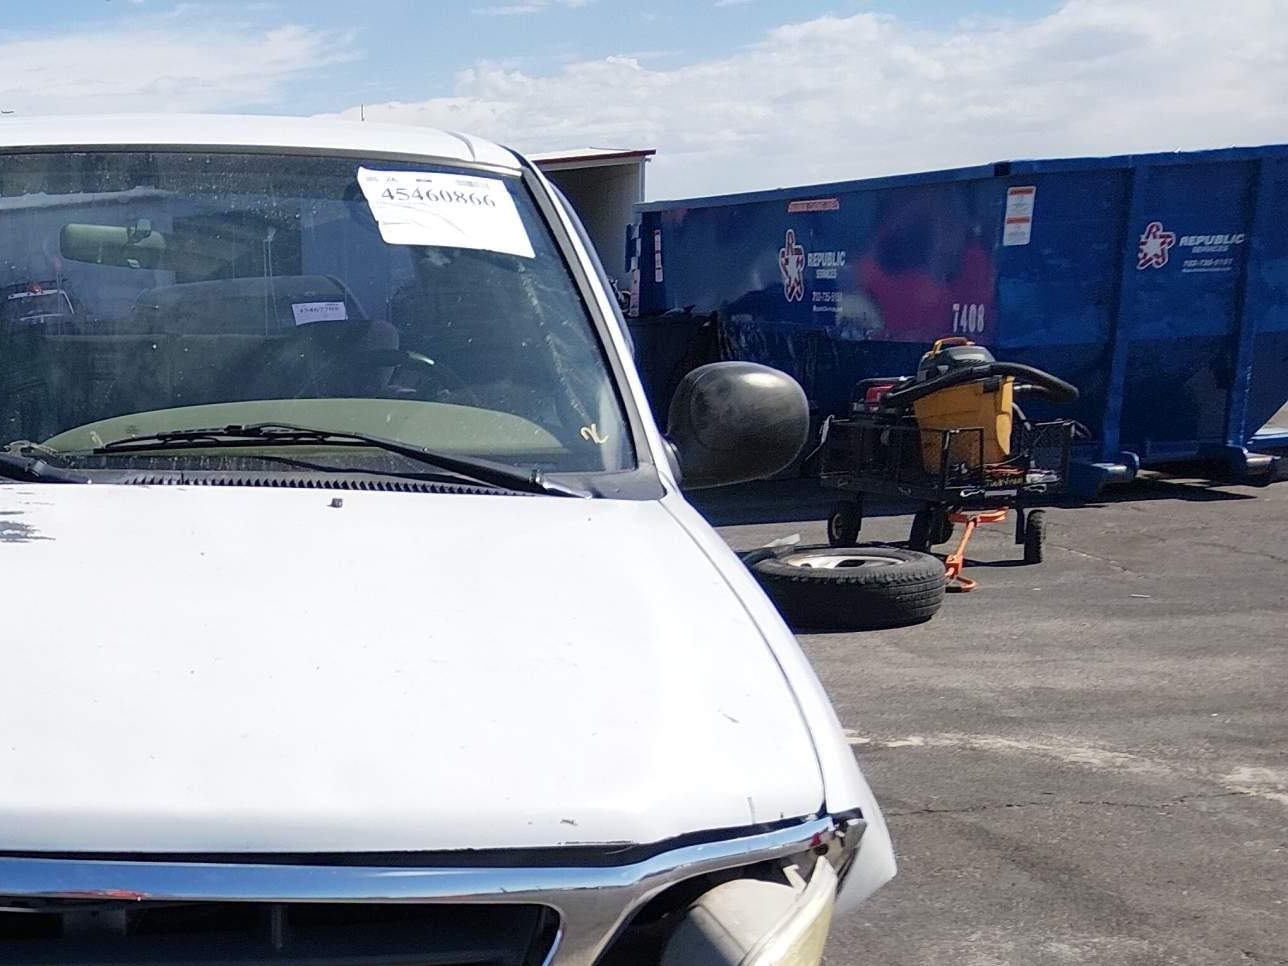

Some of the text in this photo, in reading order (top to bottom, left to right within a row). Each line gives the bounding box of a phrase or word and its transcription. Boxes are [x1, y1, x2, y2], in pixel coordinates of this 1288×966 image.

[380, 187, 497, 208] 45460866
[1179, 233, 1245, 247] REPUBLIC
[807, 251, 846, 266] REPUBLIC
[952, 303, 985, 332] 7408
